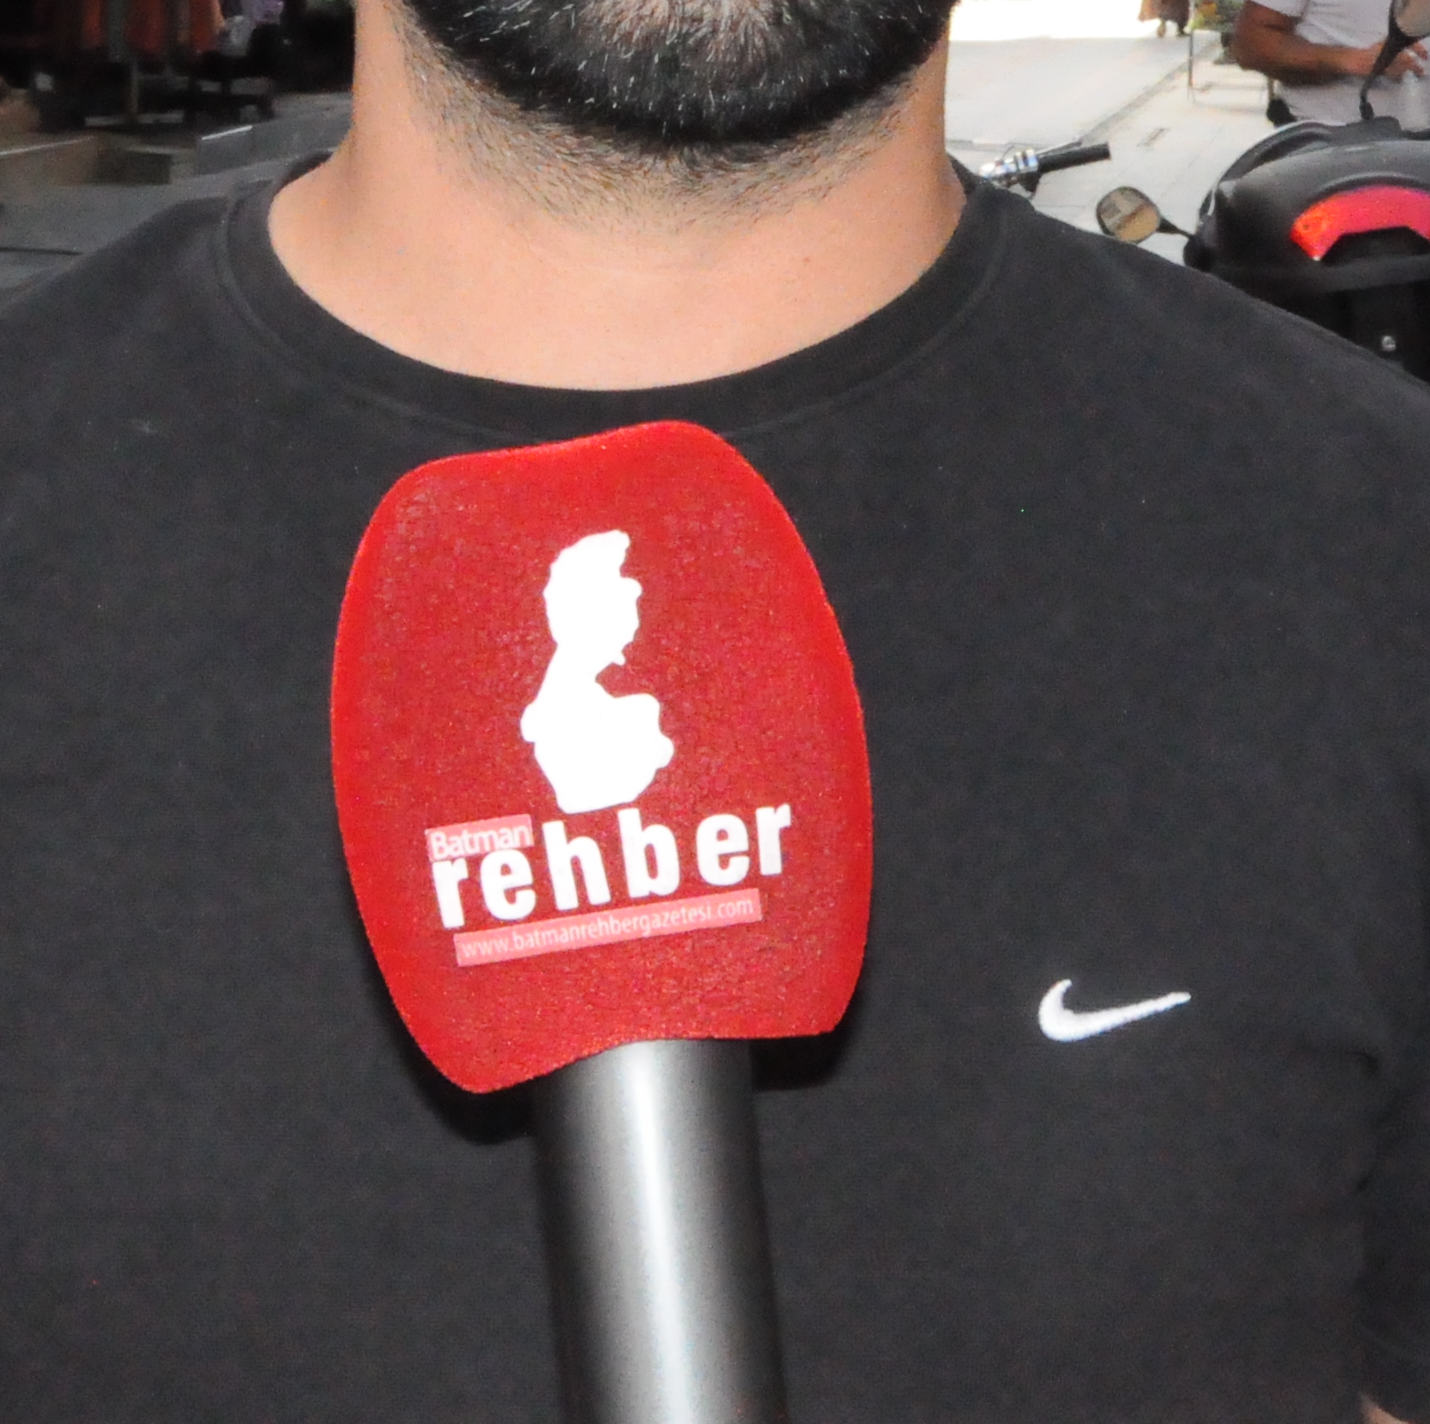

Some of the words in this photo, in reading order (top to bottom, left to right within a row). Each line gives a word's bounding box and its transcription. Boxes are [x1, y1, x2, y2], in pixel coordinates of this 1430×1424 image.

[429, 823, 532, 859] Batman
[431, 803, 792, 929] rehber
[460, 897, 755, 959] www.batmanrehbergazetesi.com
